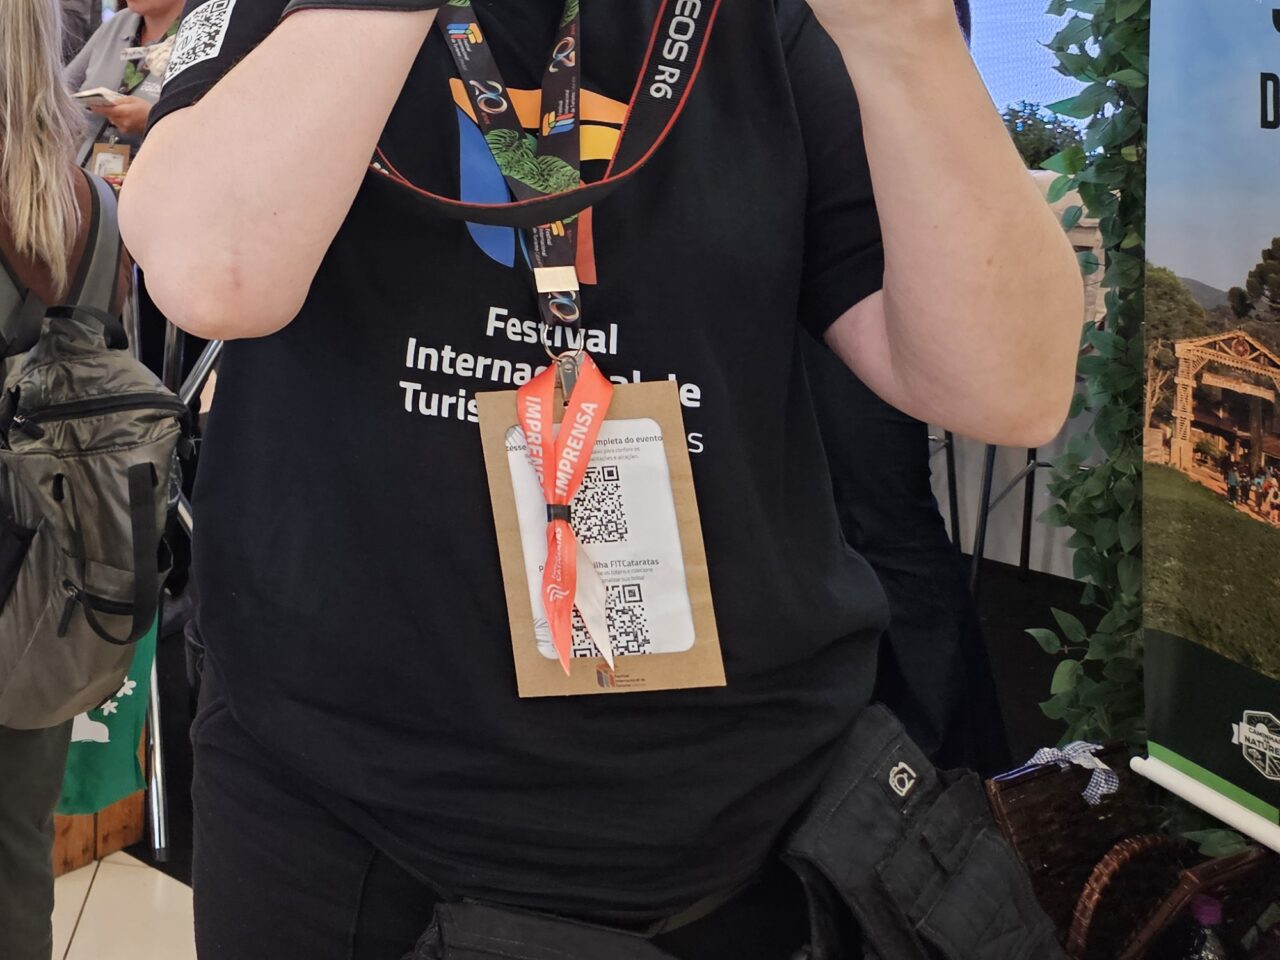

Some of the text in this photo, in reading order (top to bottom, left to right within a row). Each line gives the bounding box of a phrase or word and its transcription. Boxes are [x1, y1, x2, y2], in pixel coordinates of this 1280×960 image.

[649, 64, 681, 99] R6
[486, 306, 619, 356] Festival
[399, 380, 480, 423] Turis
[555, 401, 599, 497] IMPRENSA
[595, 435, 664, 446] mpleta do evento
[610, 559, 660, 568] FITCataratas
